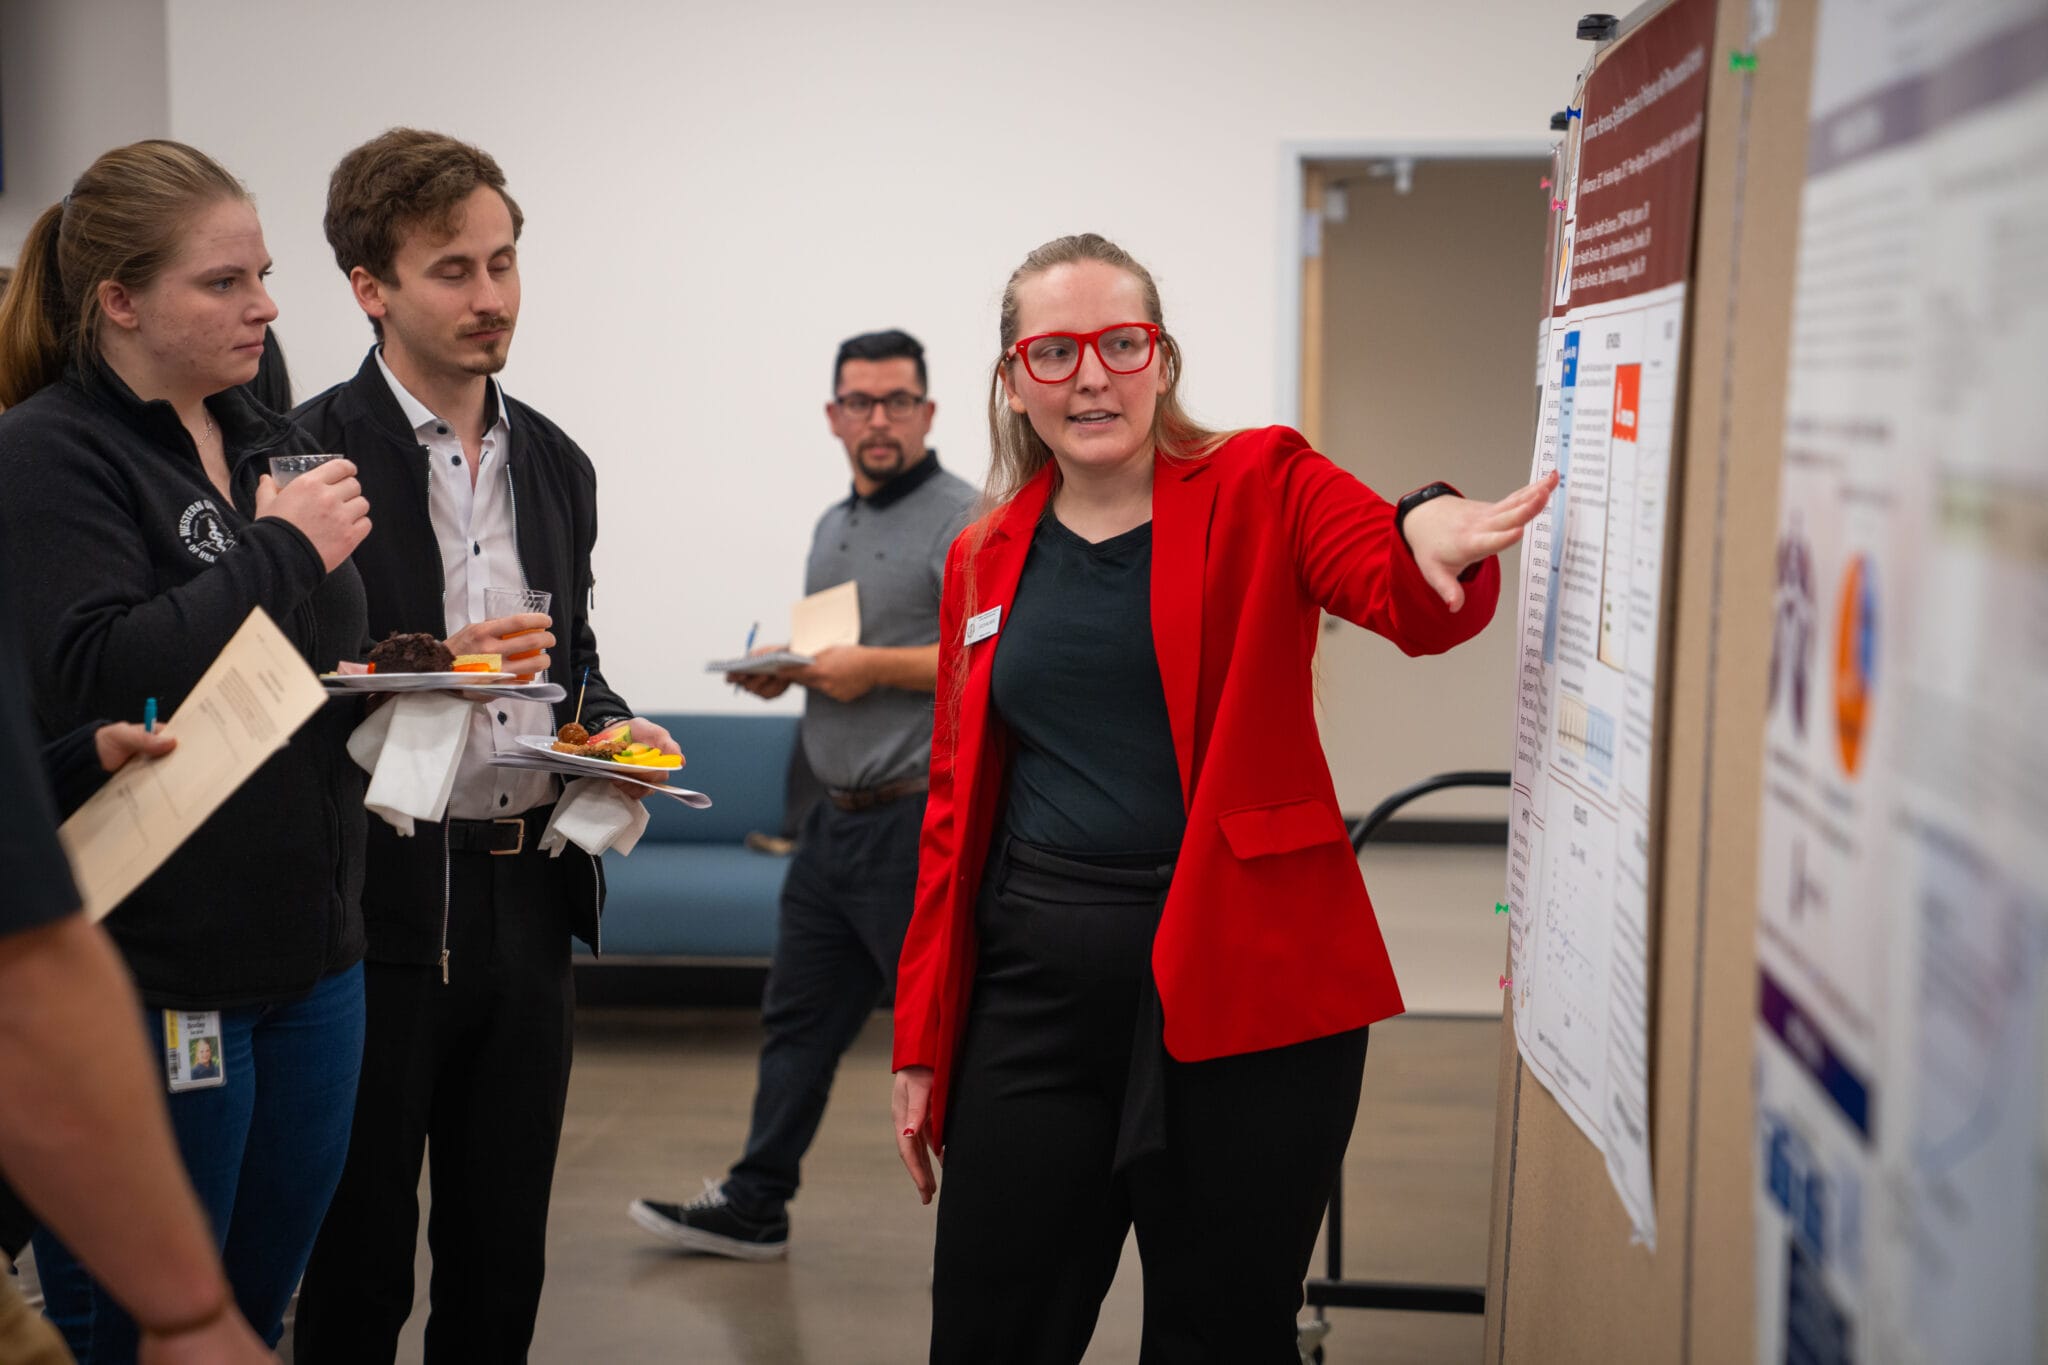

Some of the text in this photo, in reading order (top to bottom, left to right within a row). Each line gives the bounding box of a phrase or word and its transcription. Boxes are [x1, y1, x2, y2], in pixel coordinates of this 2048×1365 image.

[179, 500, 204, 537] WESTERN
[188, 544, 216, 563] OF HEA
